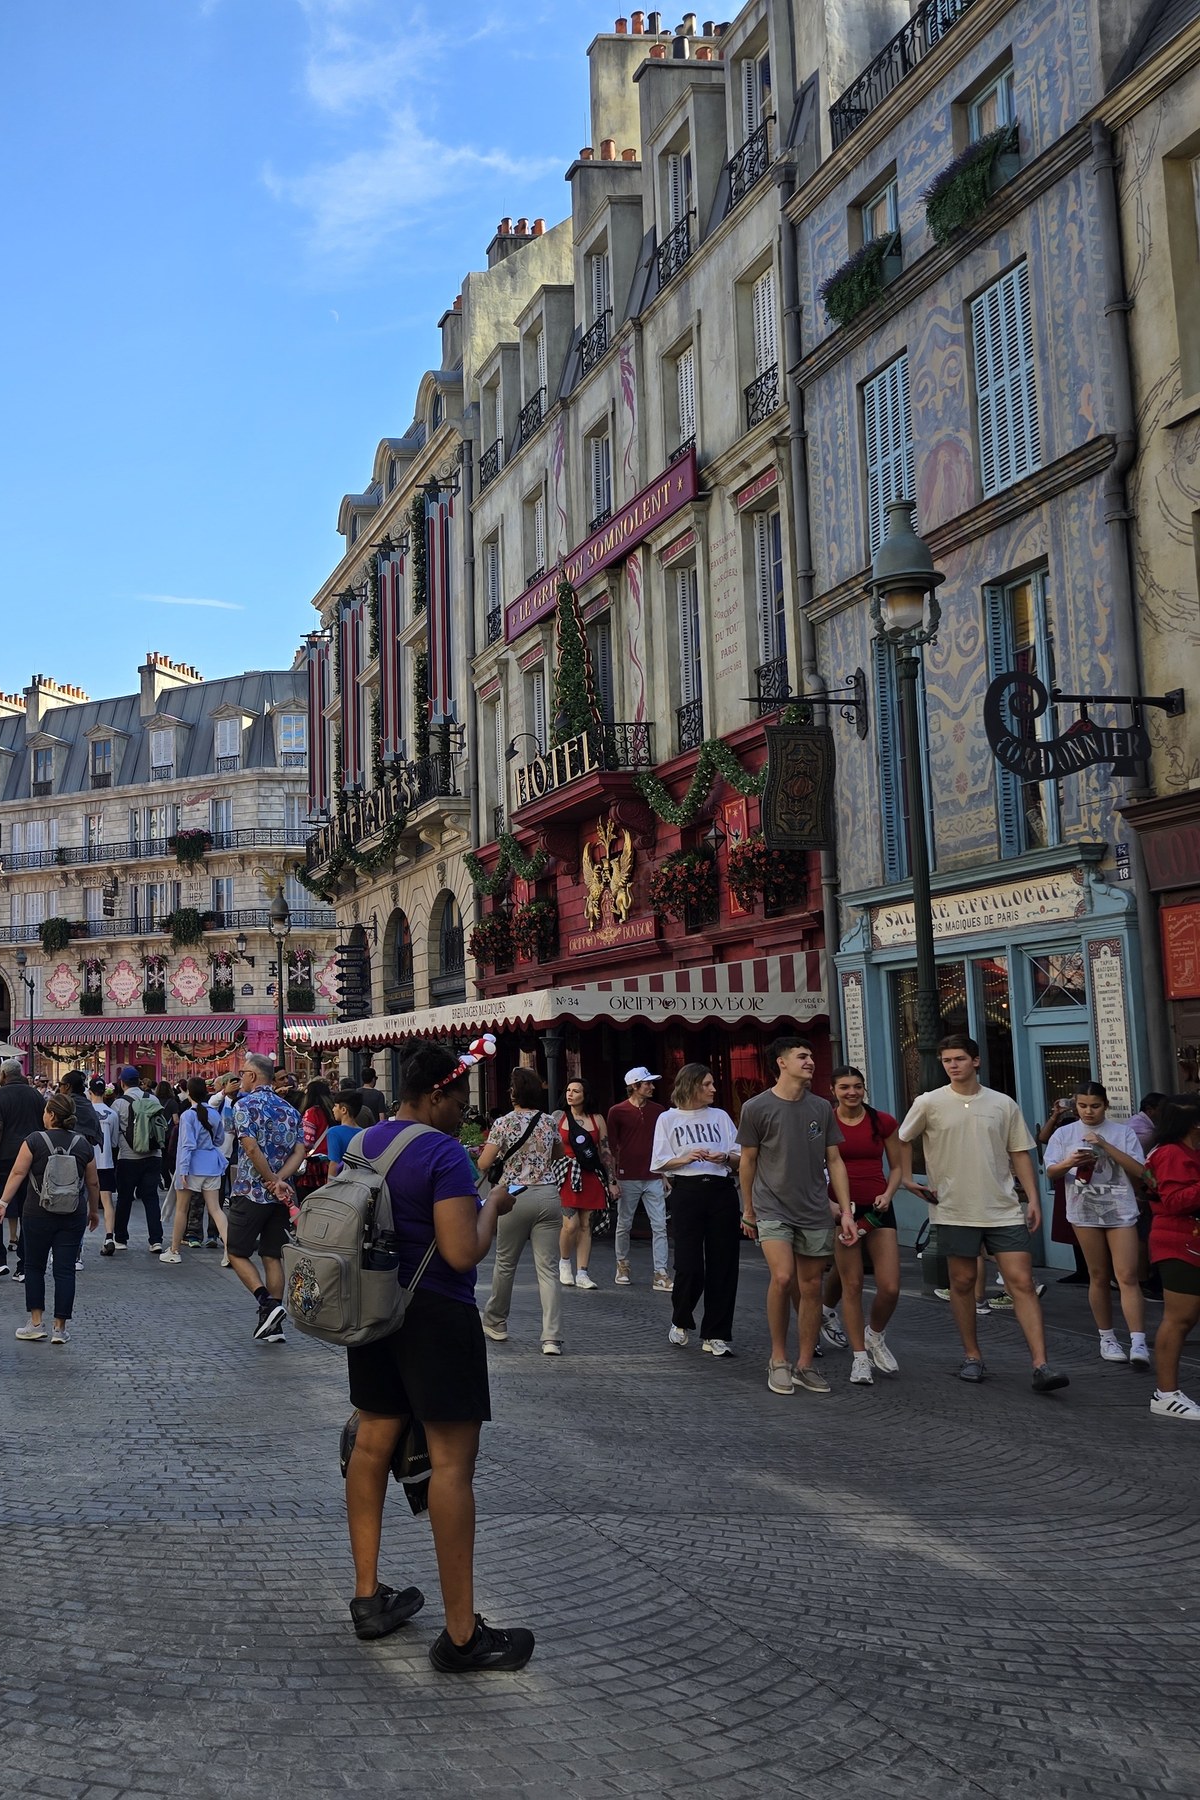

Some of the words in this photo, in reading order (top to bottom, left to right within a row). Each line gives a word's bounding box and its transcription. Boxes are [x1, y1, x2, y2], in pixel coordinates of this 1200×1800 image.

[518, 603, 532, 622] LE
[587, 480, 672, 569] SOMNOLENT
[723, 589, 730, 600] ET
[715, 630, 724, 643] DU
[721, 642, 738, 660] PARIS
[996, 732, 1140, 776] CORDONNIER
[1118, 866, 1129, 880] 18
[953, 878, 1063, 915] EFFILOCHÉ
[945, 918, 982, 933] MAGIQUES
[984, 915, 994, 926] DE
[997, 910, 1019, 923] PARIS
[478, 1000, 506, 1017] MAGIQUES
[568, 997, 579, 1006] 34
[795, 996, 815, 1004] FONDÉ
[674, 1123, 722, 1147] PARIS
